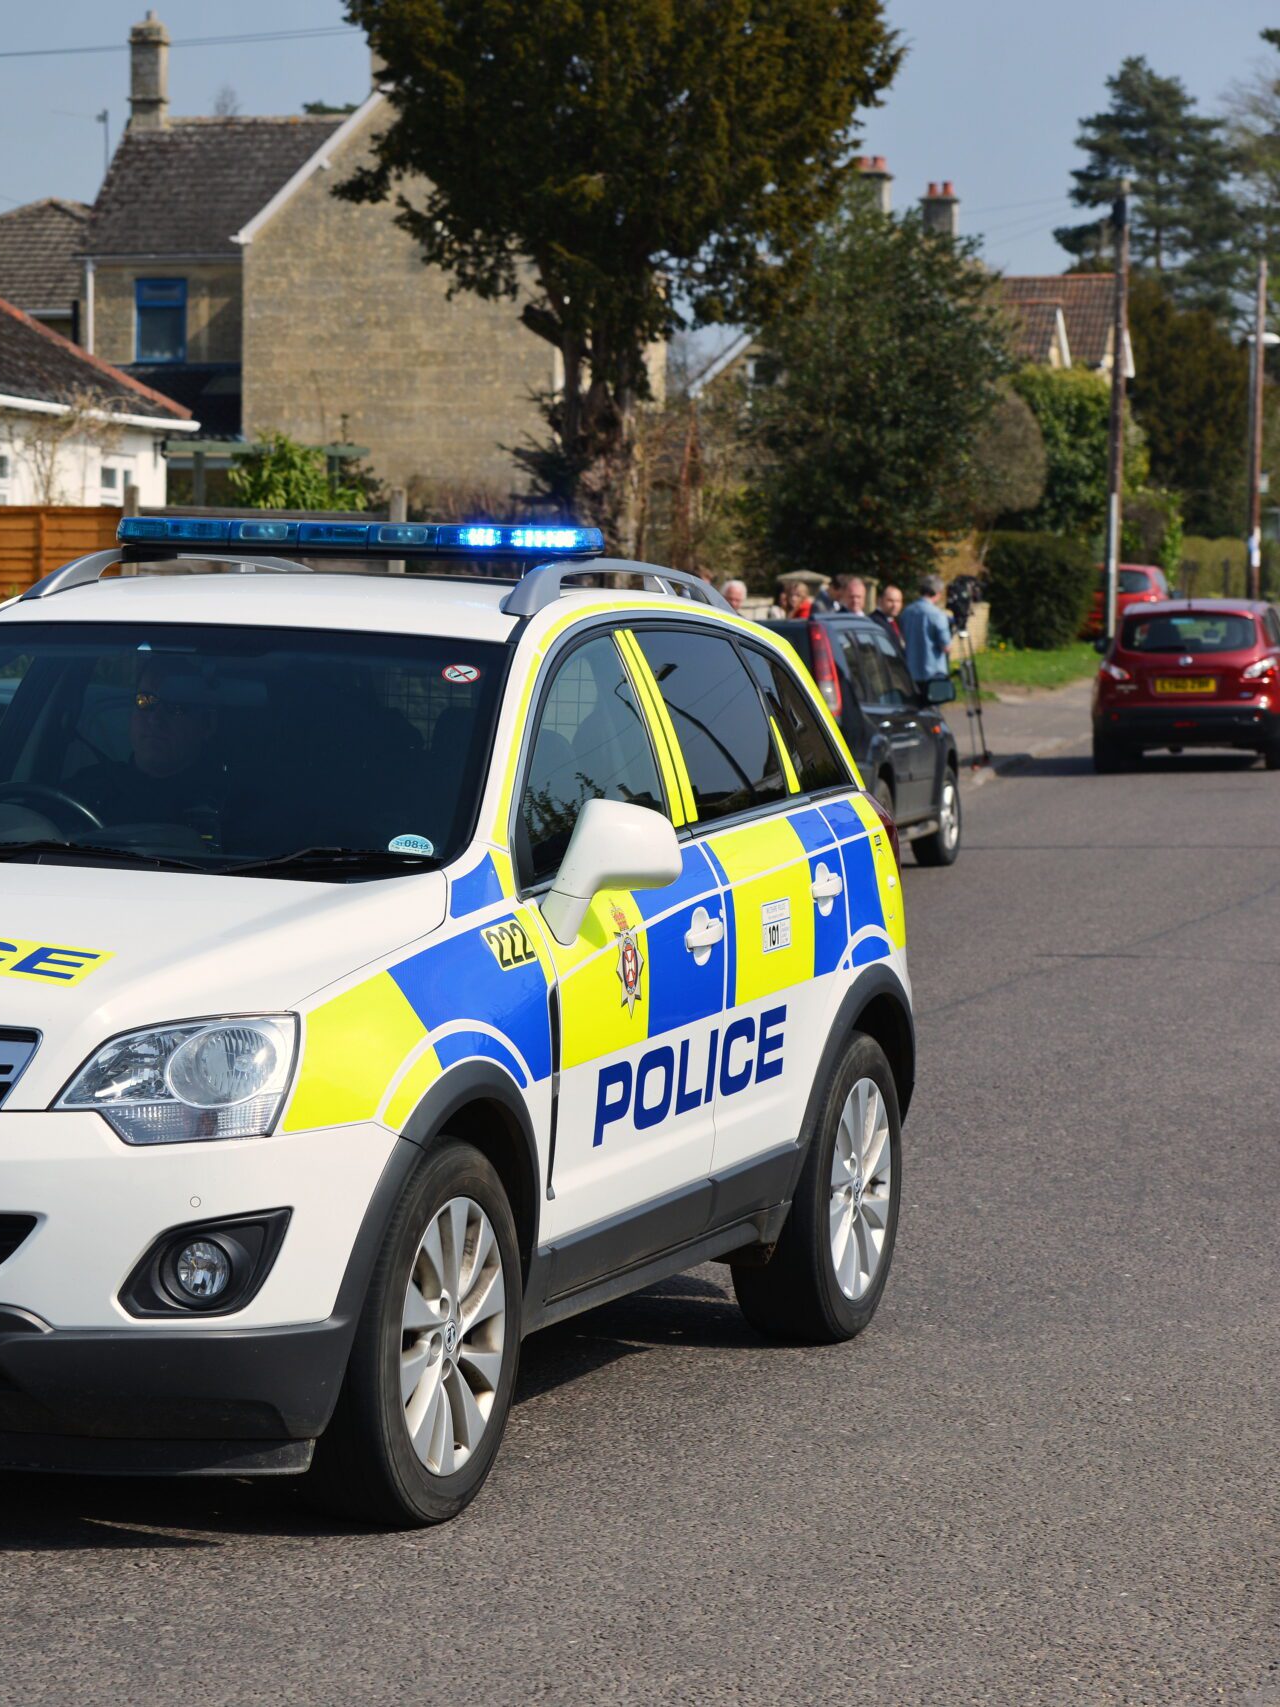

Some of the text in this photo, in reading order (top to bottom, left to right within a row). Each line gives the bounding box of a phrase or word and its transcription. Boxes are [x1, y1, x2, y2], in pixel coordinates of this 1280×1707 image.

[486, 922, 536, 968] 222
[768, 924, 780, 948] 101
[593, 1004, 787, 1148] POLICE
